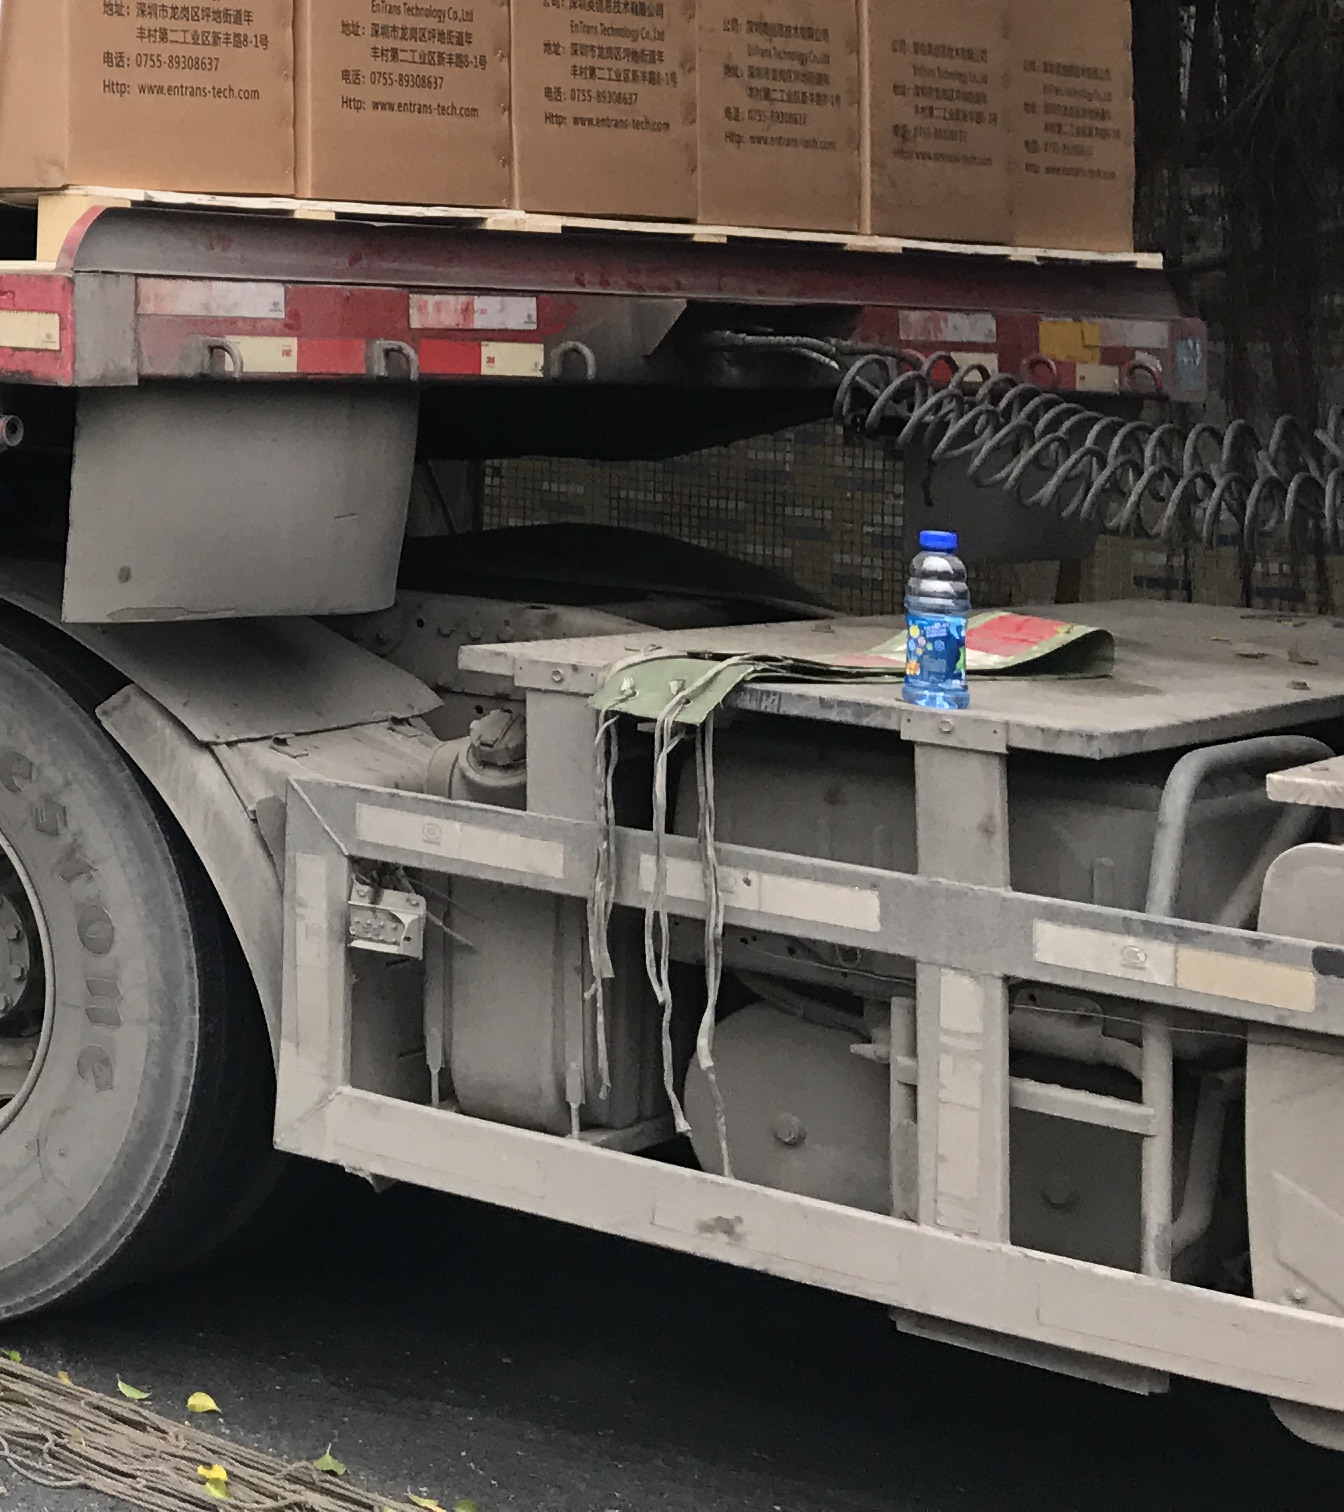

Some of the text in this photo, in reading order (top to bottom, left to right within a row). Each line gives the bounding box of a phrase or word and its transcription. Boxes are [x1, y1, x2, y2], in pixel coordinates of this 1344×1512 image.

[371, 0, 401, 16] EnTrans
[403, 2, 446, 23] Technology
[136, 53, 219, 71] 0755-89308637
[103, 79, 259, 100] Http: www.entrans-tech.com
[370, 71, 443, 89] 0755-89308637
[341, 95, 478, 117] Http: www.entrans-tech.com
